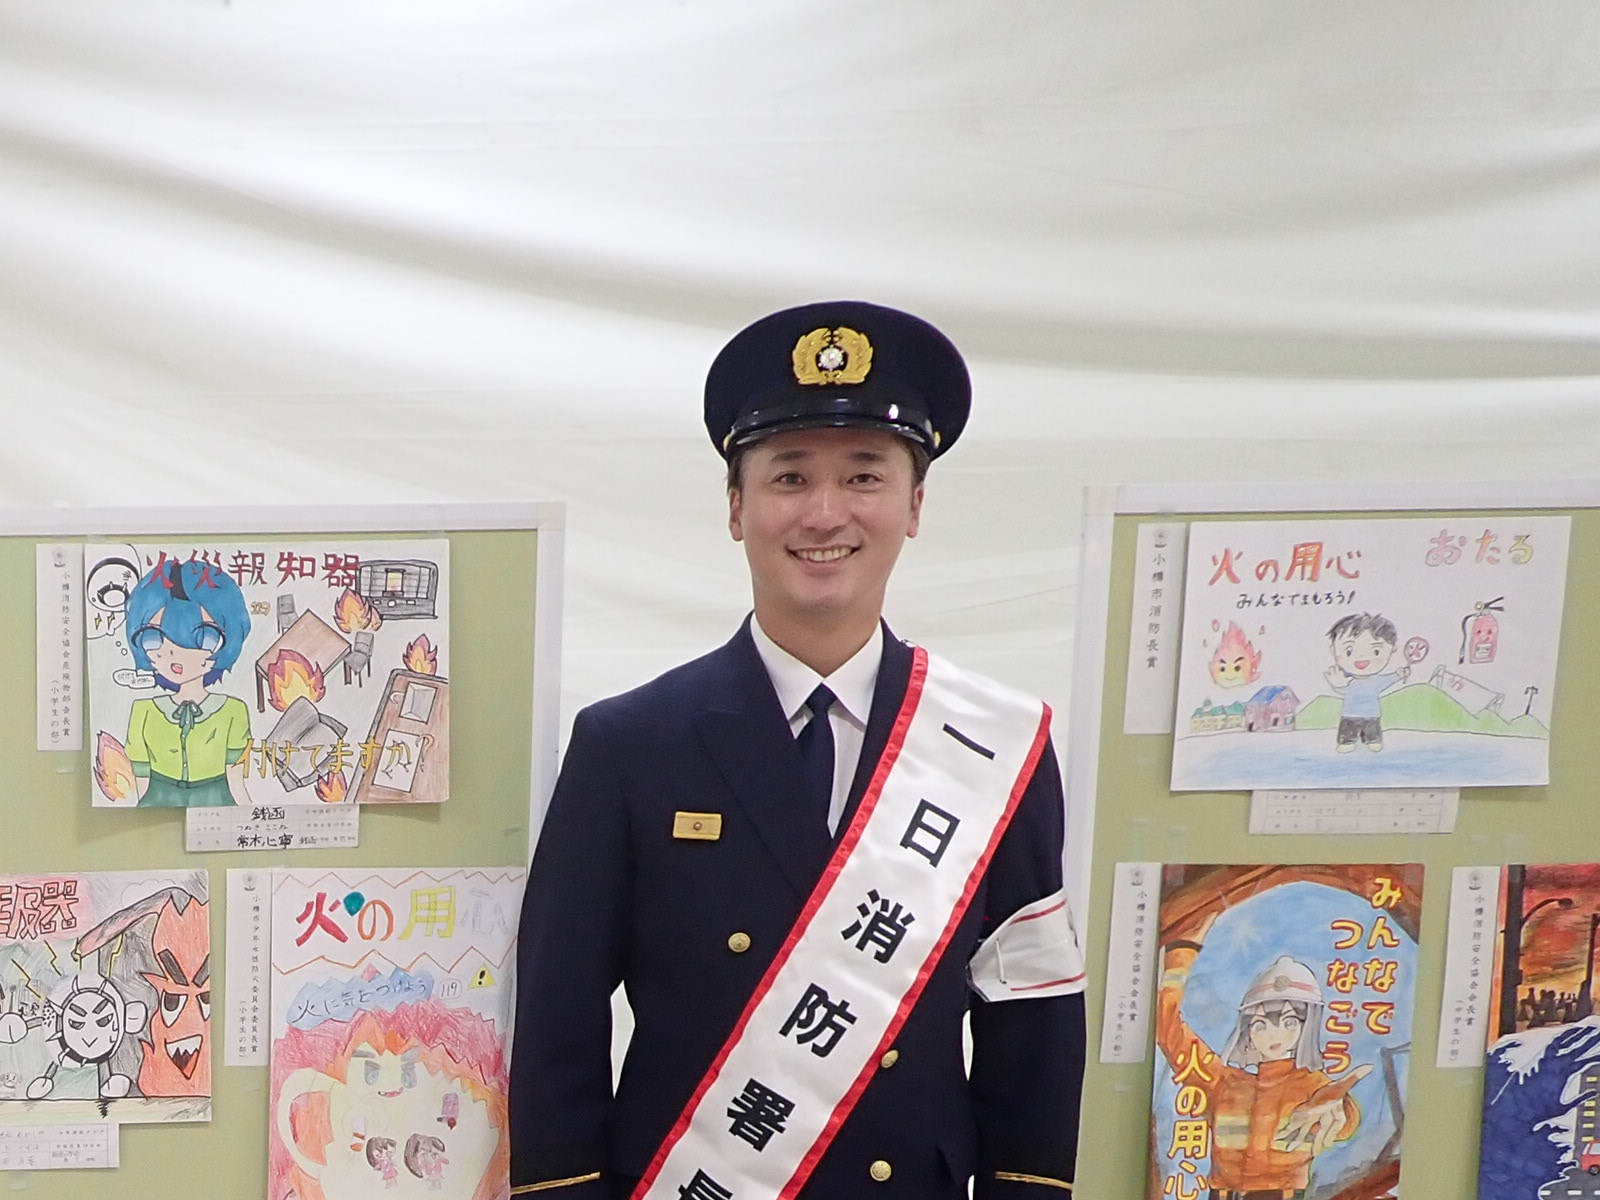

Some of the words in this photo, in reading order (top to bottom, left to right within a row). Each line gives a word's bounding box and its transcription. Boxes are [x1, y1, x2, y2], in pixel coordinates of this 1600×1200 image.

[143, 549, 360, 590] 火災報知器
[1208, 541, 1362, 586] 火の用心
[1424, 529, 1535, 568] おたる
[1146, 554, 1166, 669] 小樽市消防長賞
[1237, 590, 1357, 609] みんなでまもろう!
[241, 734, 435, 780] 付けてますか?
[1362, 877, 1402, 1035] みんなで
[291, 980, 428, 1024] 火に気をつけよう
[441, 981, 459, 999] 119
[1322, 918, 1364, 1075] つなごう
